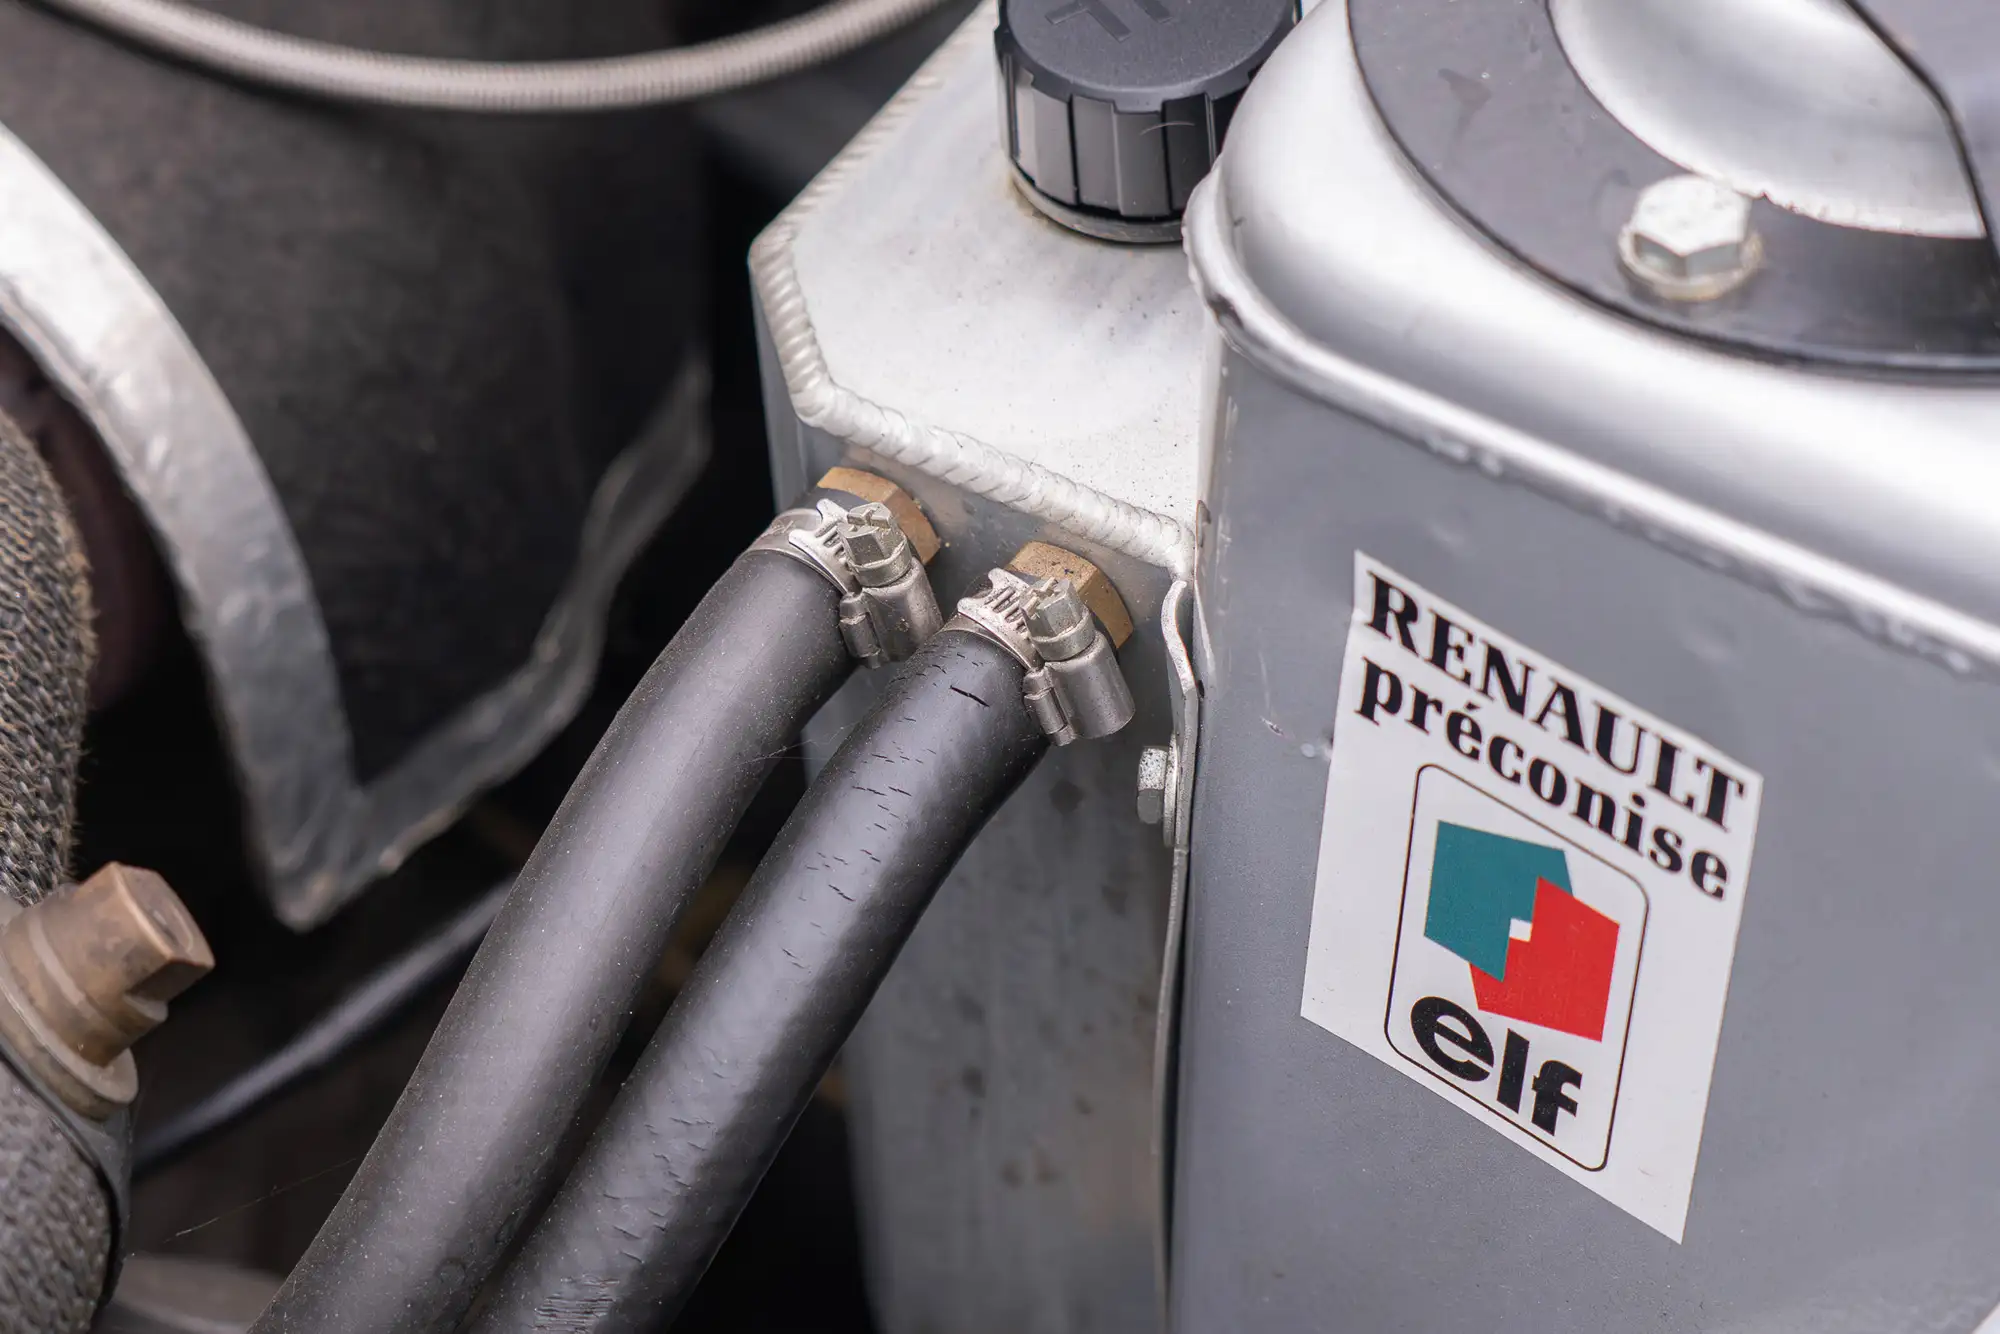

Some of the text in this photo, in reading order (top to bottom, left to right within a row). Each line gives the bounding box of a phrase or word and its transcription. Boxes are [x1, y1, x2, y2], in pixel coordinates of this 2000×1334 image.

[1354, 656, 1729, 902] préconise
[1365, 570, 1744, 832] RENAULT
[1410, 996, 1582, 1136] elf
